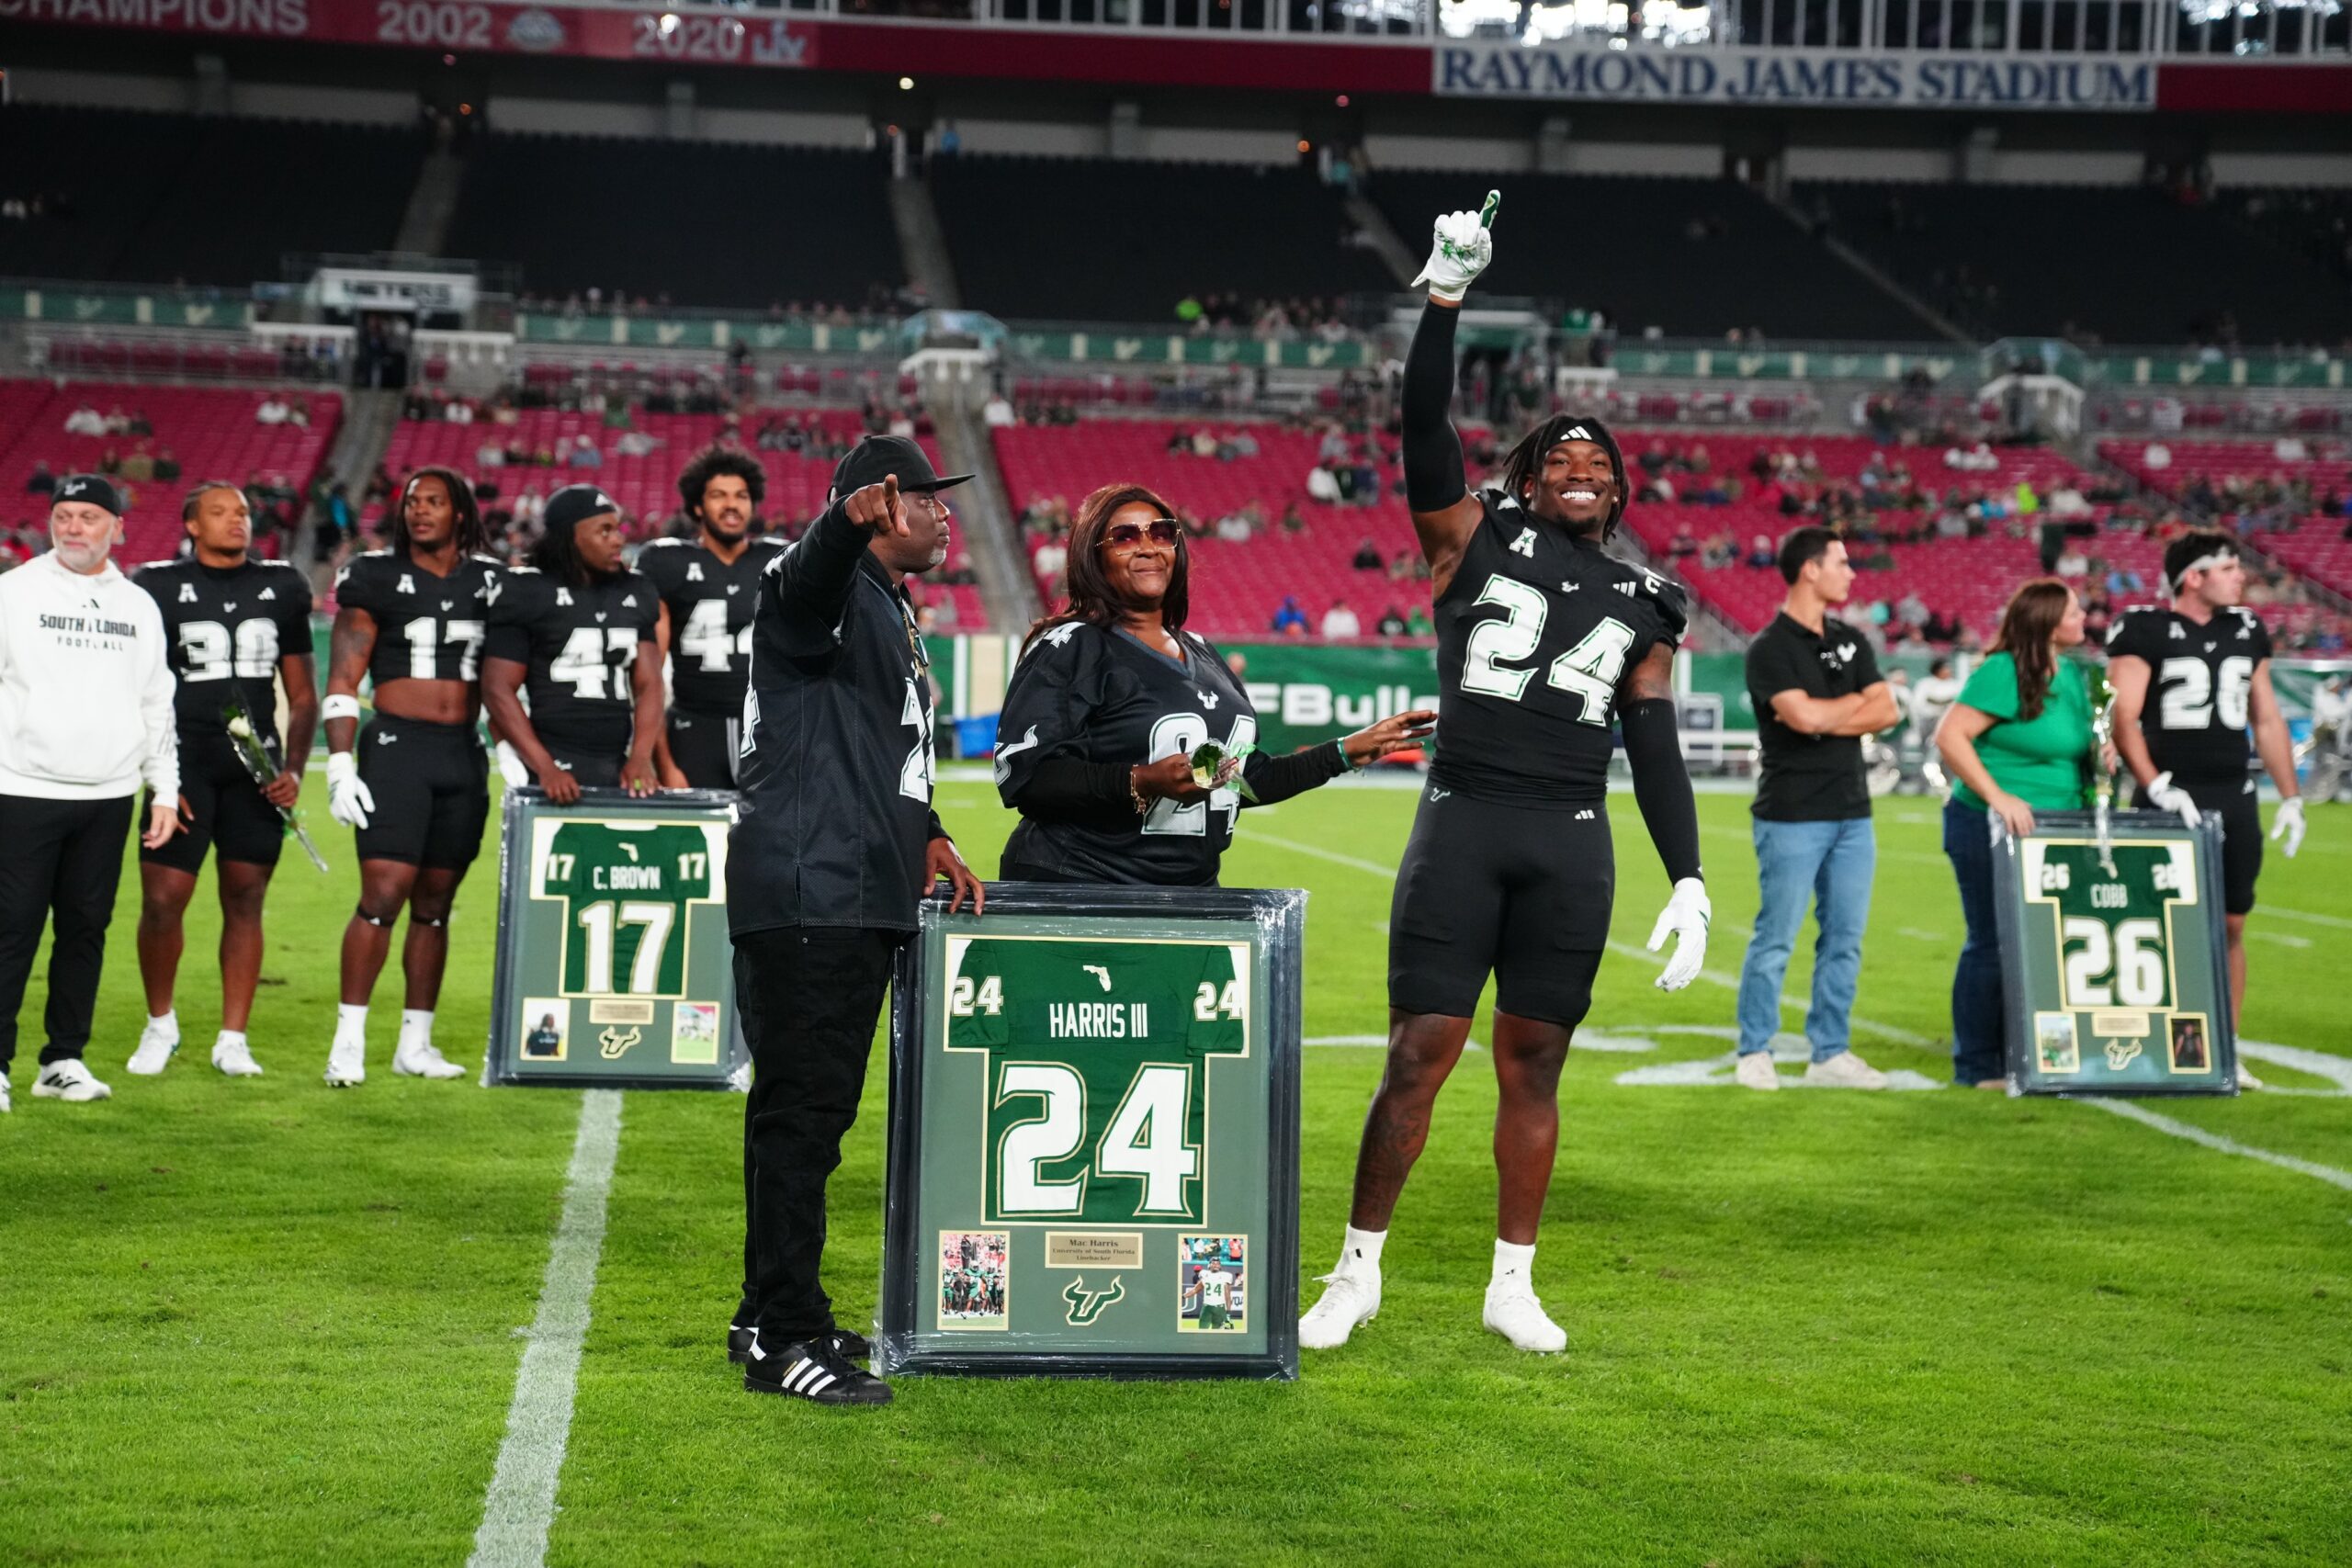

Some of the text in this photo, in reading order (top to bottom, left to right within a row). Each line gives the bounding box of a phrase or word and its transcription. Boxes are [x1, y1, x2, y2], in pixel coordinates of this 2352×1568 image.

[378, 2, 492, 45] 2002
[634, 17, 743, 60] 2020
[1442, 50, 2150, 103] RAYMOND JAMES STADIUM
[40, 614, 85, 633] SOUTH
[57, 636, 123, 651] FOOTALL
[404, 616, 485, 682] 17
[550, 627, 639, 700] 47
[1460, 573, 1636, 727] 24
[2160, 656, 2253, 730] 26
[547, 853, 576, 882] 17
[593, 866, 661, 890] C. BROWN
[678, 852, 707, 881] 17
[2090, 884, 2129, 908] COBB
[578, 900, 676, 994] 17
[2064, 917, 2165, 1007] 26
[951, 976, 1003, 1017] 24
[1193, 980, 1242, 1021] 24
[1049, 1002, 1148, 1038] HARRIS III
[994, 1061, 1201, 1217] 24
[1069, 1239, 1087, 1247] Mac
[1205, 1282, 1222, 1296] 24
